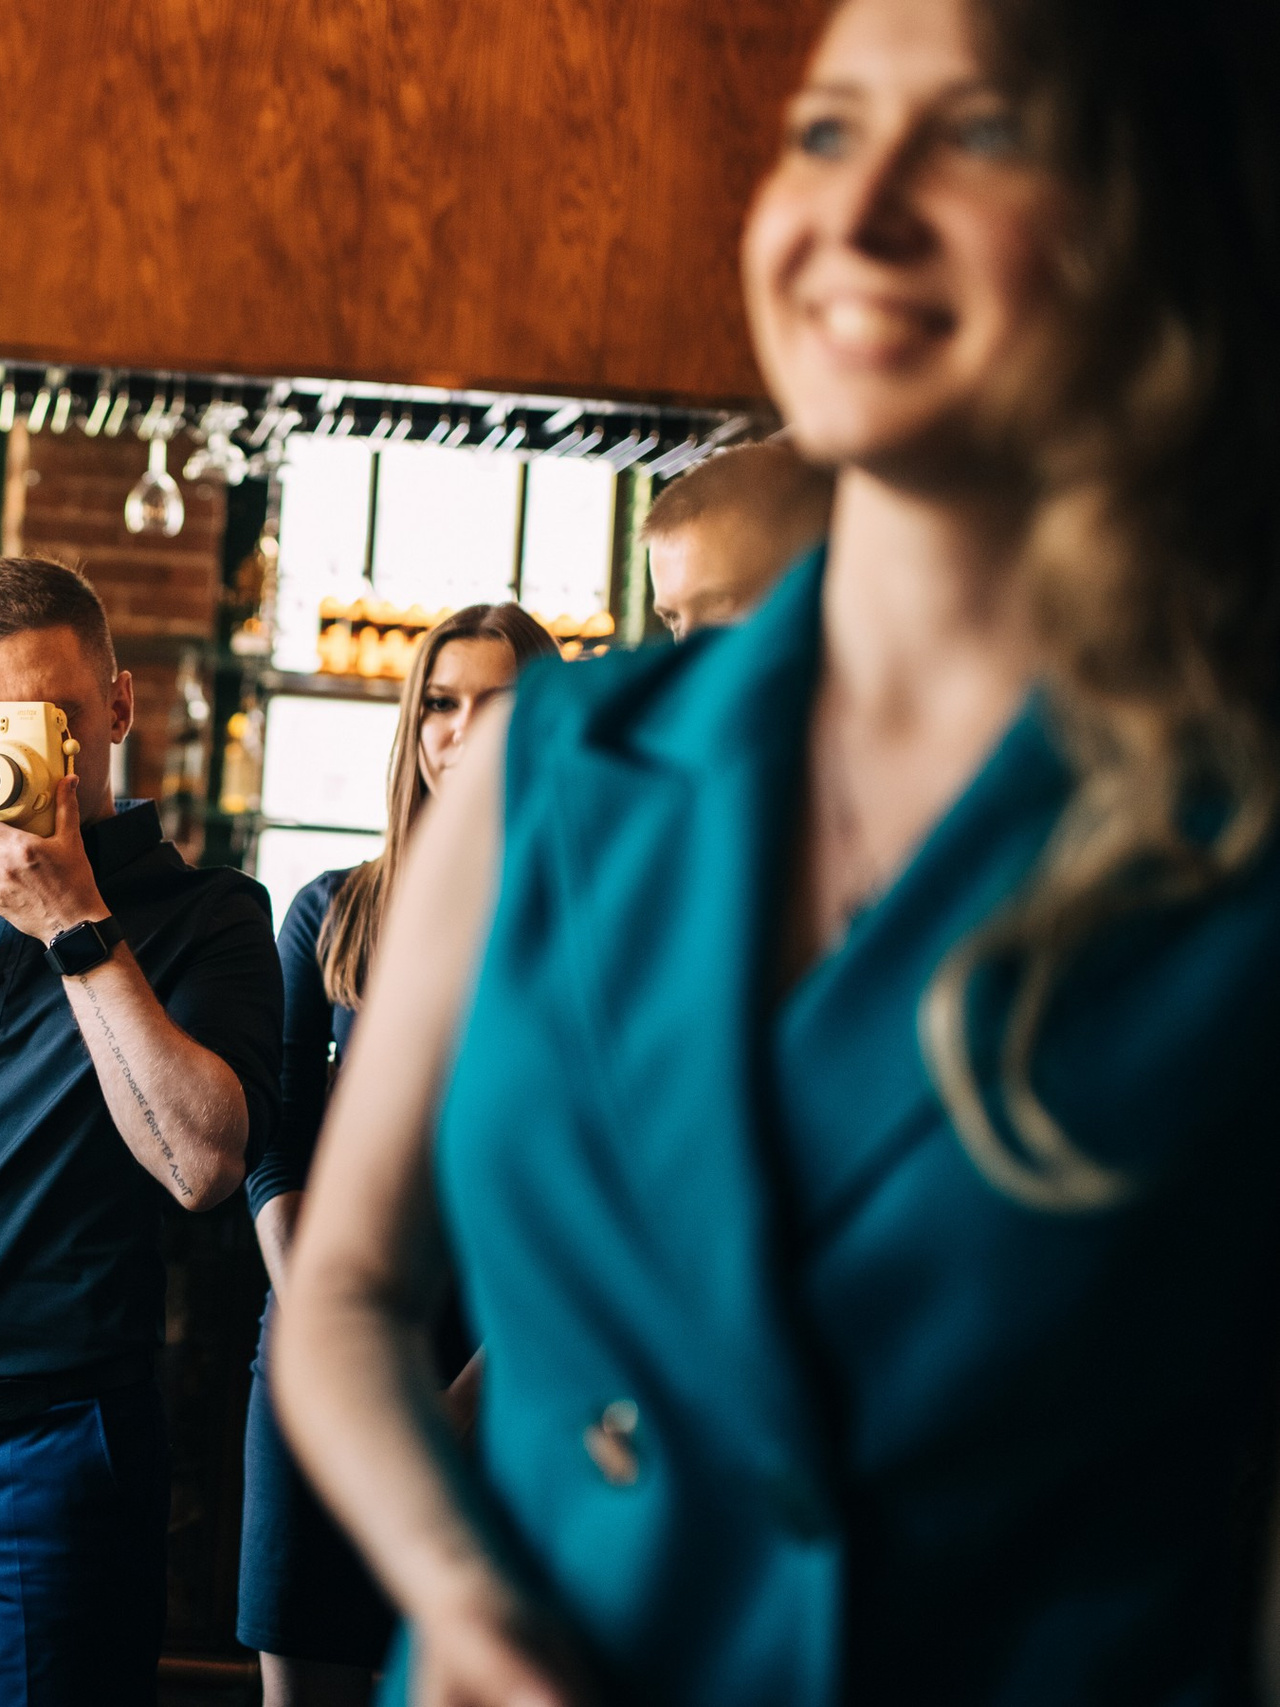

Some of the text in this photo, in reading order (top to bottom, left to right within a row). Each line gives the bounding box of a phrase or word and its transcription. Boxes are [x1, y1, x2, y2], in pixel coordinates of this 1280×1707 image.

[79, 975, 97, 1003] QUOD
[112, 1047, 148, 1107] DEFENDERE
[169, 1162, 193, 1197] AUDIT
